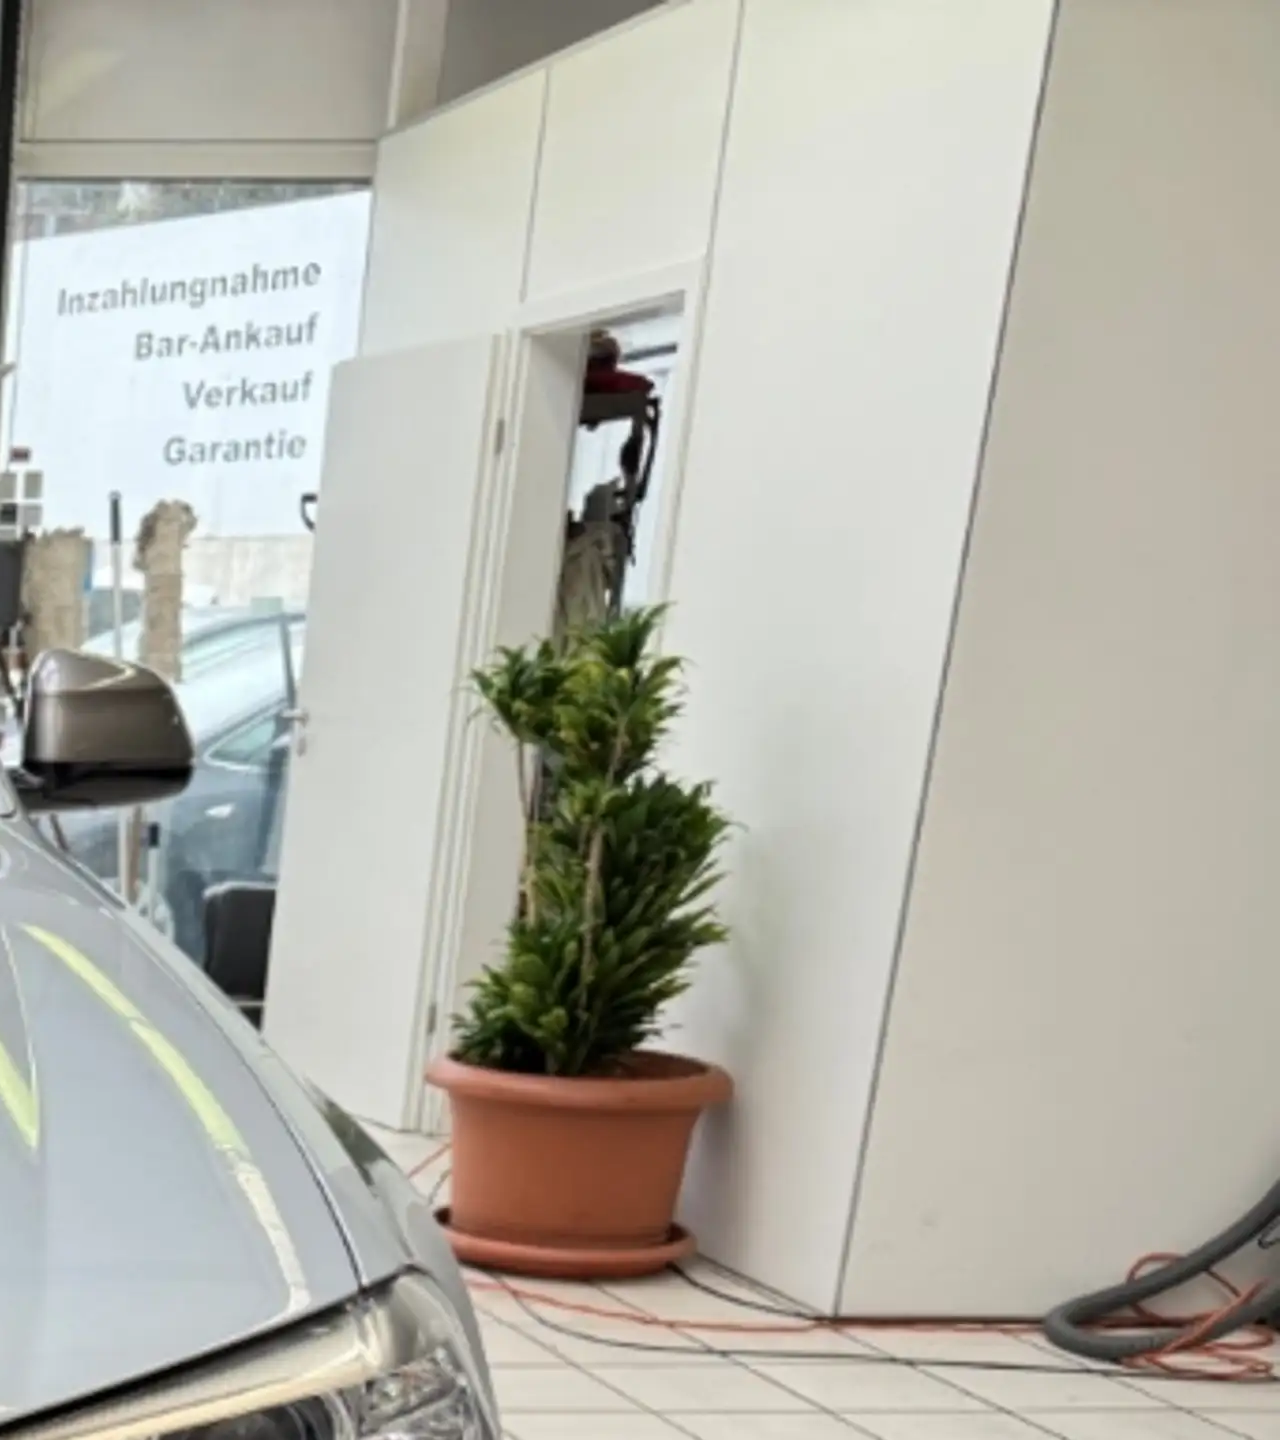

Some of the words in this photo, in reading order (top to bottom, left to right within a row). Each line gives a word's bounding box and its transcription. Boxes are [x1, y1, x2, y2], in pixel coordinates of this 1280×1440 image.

[57, 261, 322, 317] Inzahlungnahme
[134, 311, 321, 361] Bar-Ankauf
[183, 369, 314, 410] Verkauf
[163, 429, 308, 466] Garantie
